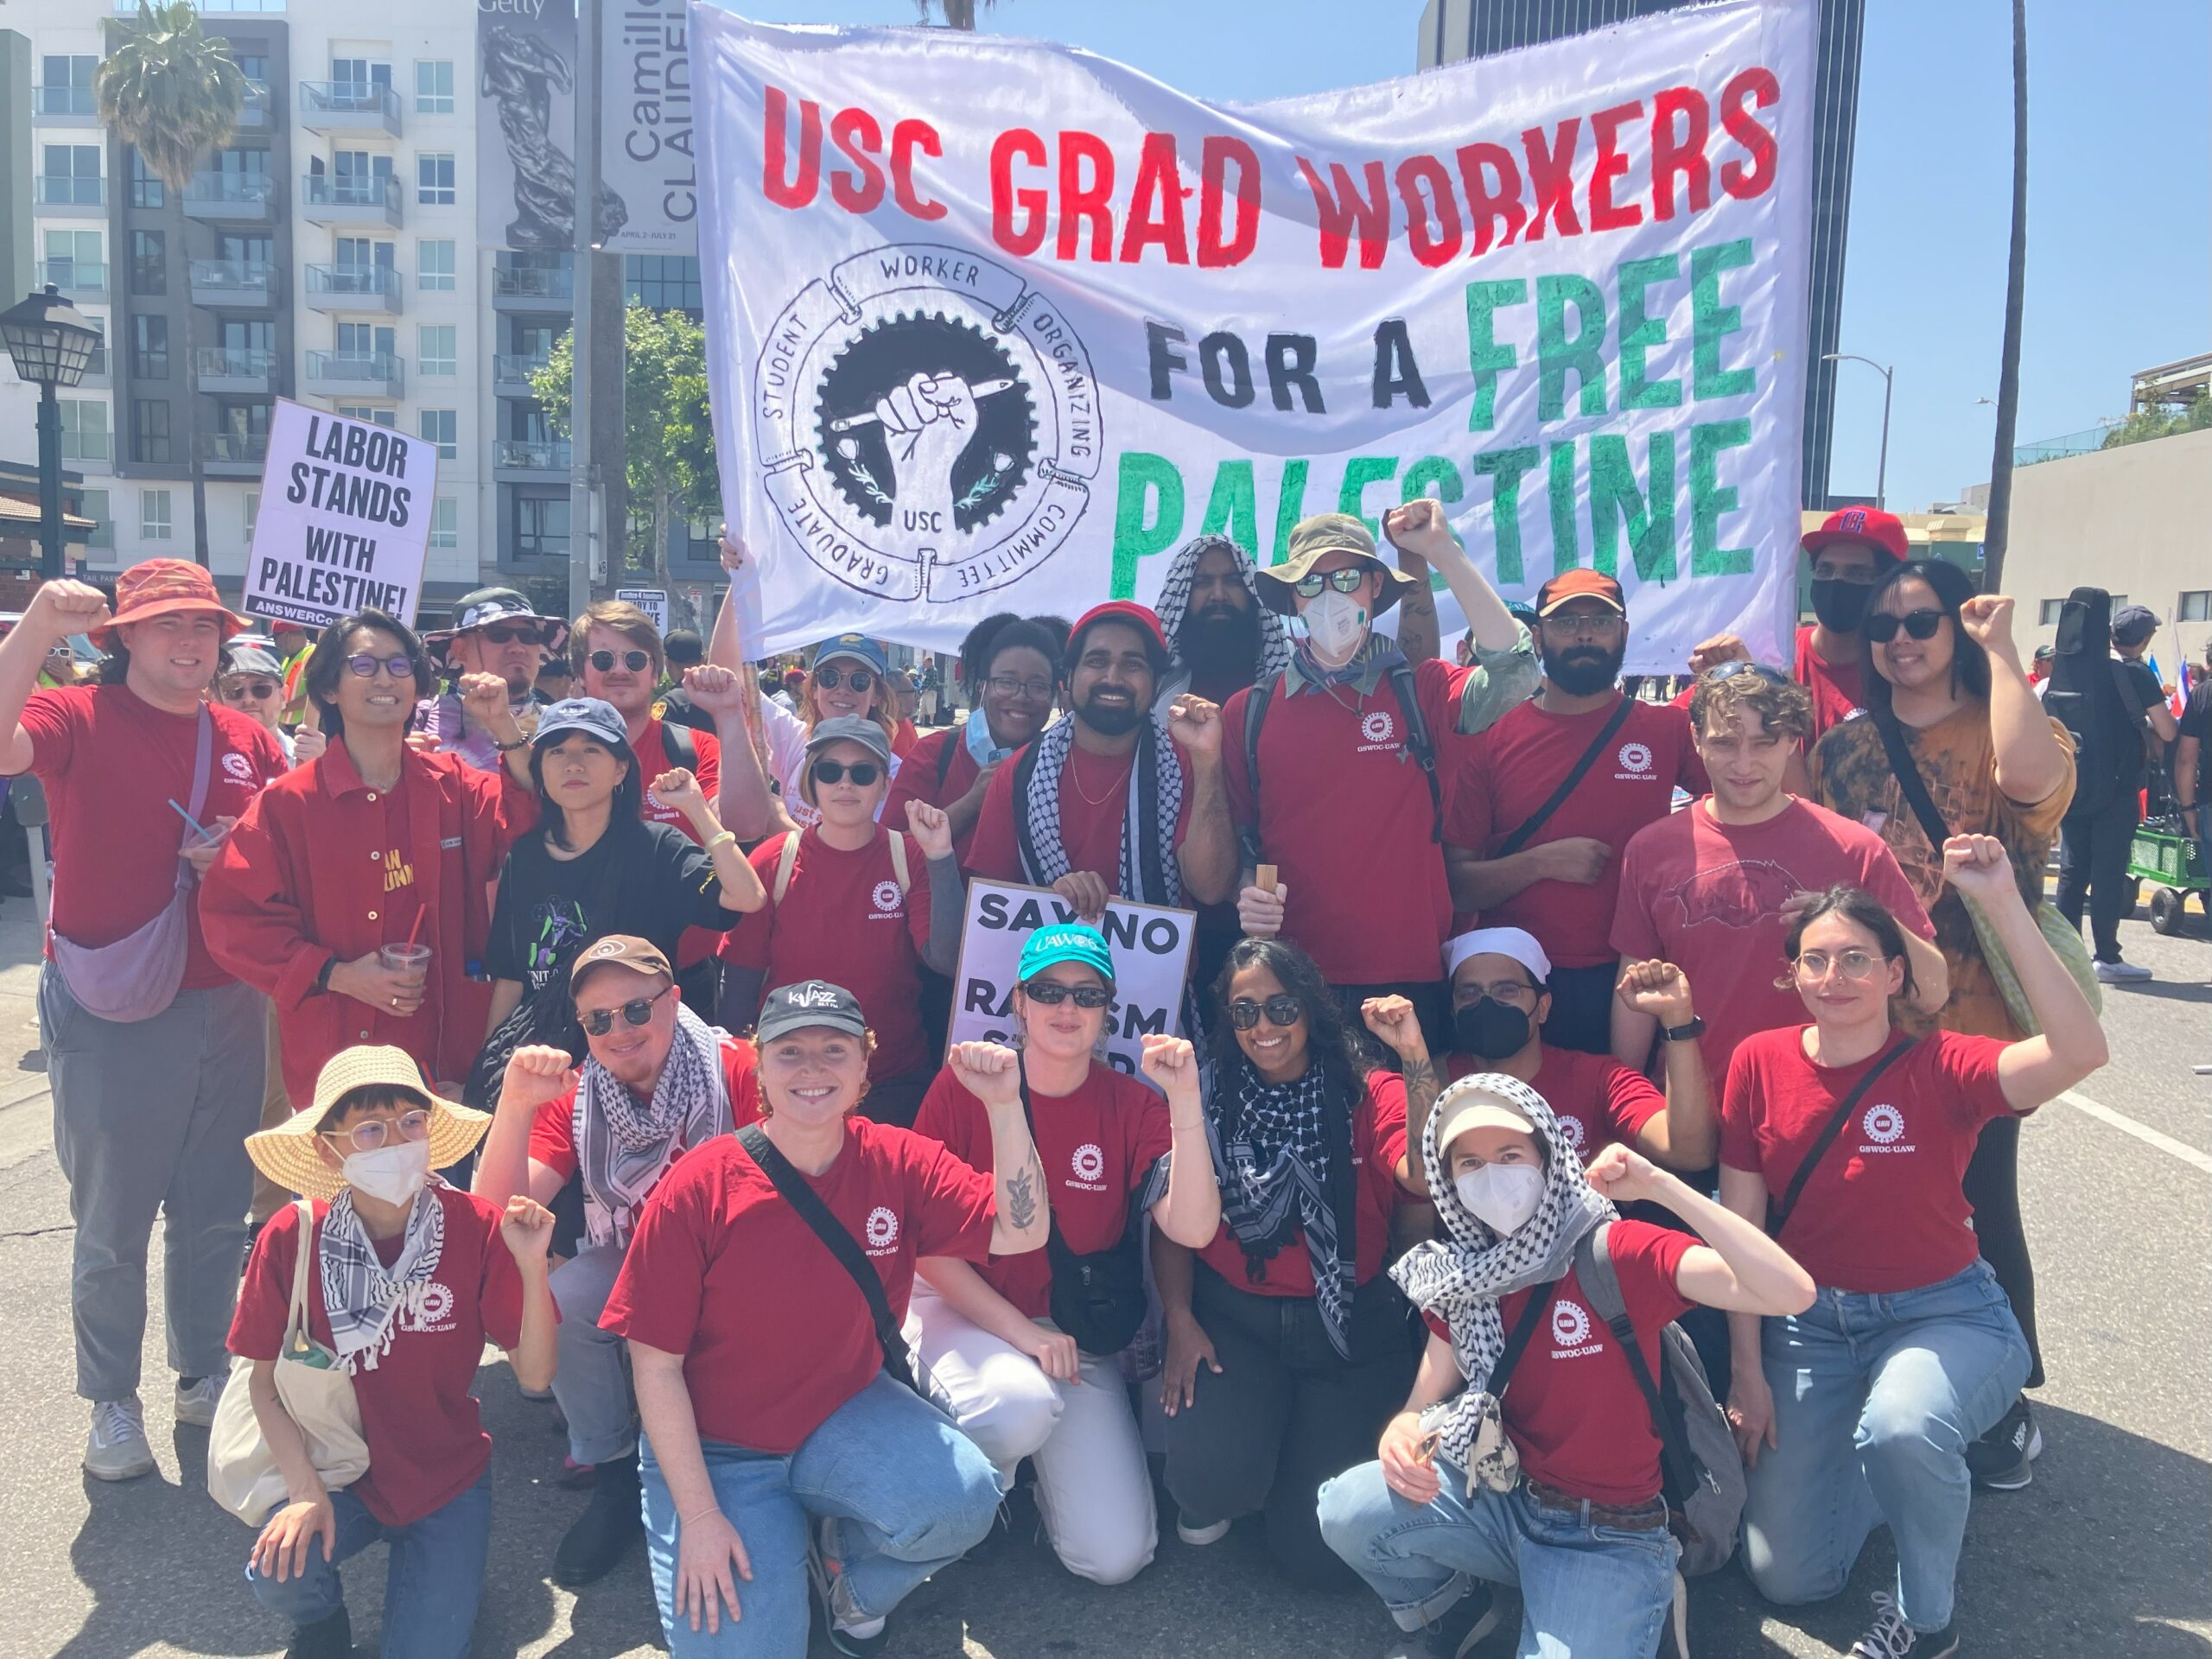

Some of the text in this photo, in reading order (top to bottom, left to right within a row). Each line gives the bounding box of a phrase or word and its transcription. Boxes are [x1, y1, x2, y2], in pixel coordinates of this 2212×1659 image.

[623, 0, 661, 162] Camill
[764, 67, 1781, 270] USC GRAD WORKERS
[880, 255, 979, 285] WORKER
[763, 314, 808, 420] STUDENT
[1144, 238, 1757, 432] FOR A FREE
[1033, 314, 1090, 459] ORGANIZING
[306, 416, 408, 479] LABOR
[287, 461, 411, 528] STANDS
[904, 511, 943, 534] USC
[306, 525, 376, 574] WITH
[788, 498, 889, 585] GRADUATE
[958, 504, 1066, 588] COMMITTEE
[256, 601, 334, 626] ANSWERCo
[259, 557, 407, 620] PALESTINE!
[1036, 933, 1073, 951] UAW
[1103, 910, 1179, 954] NO
